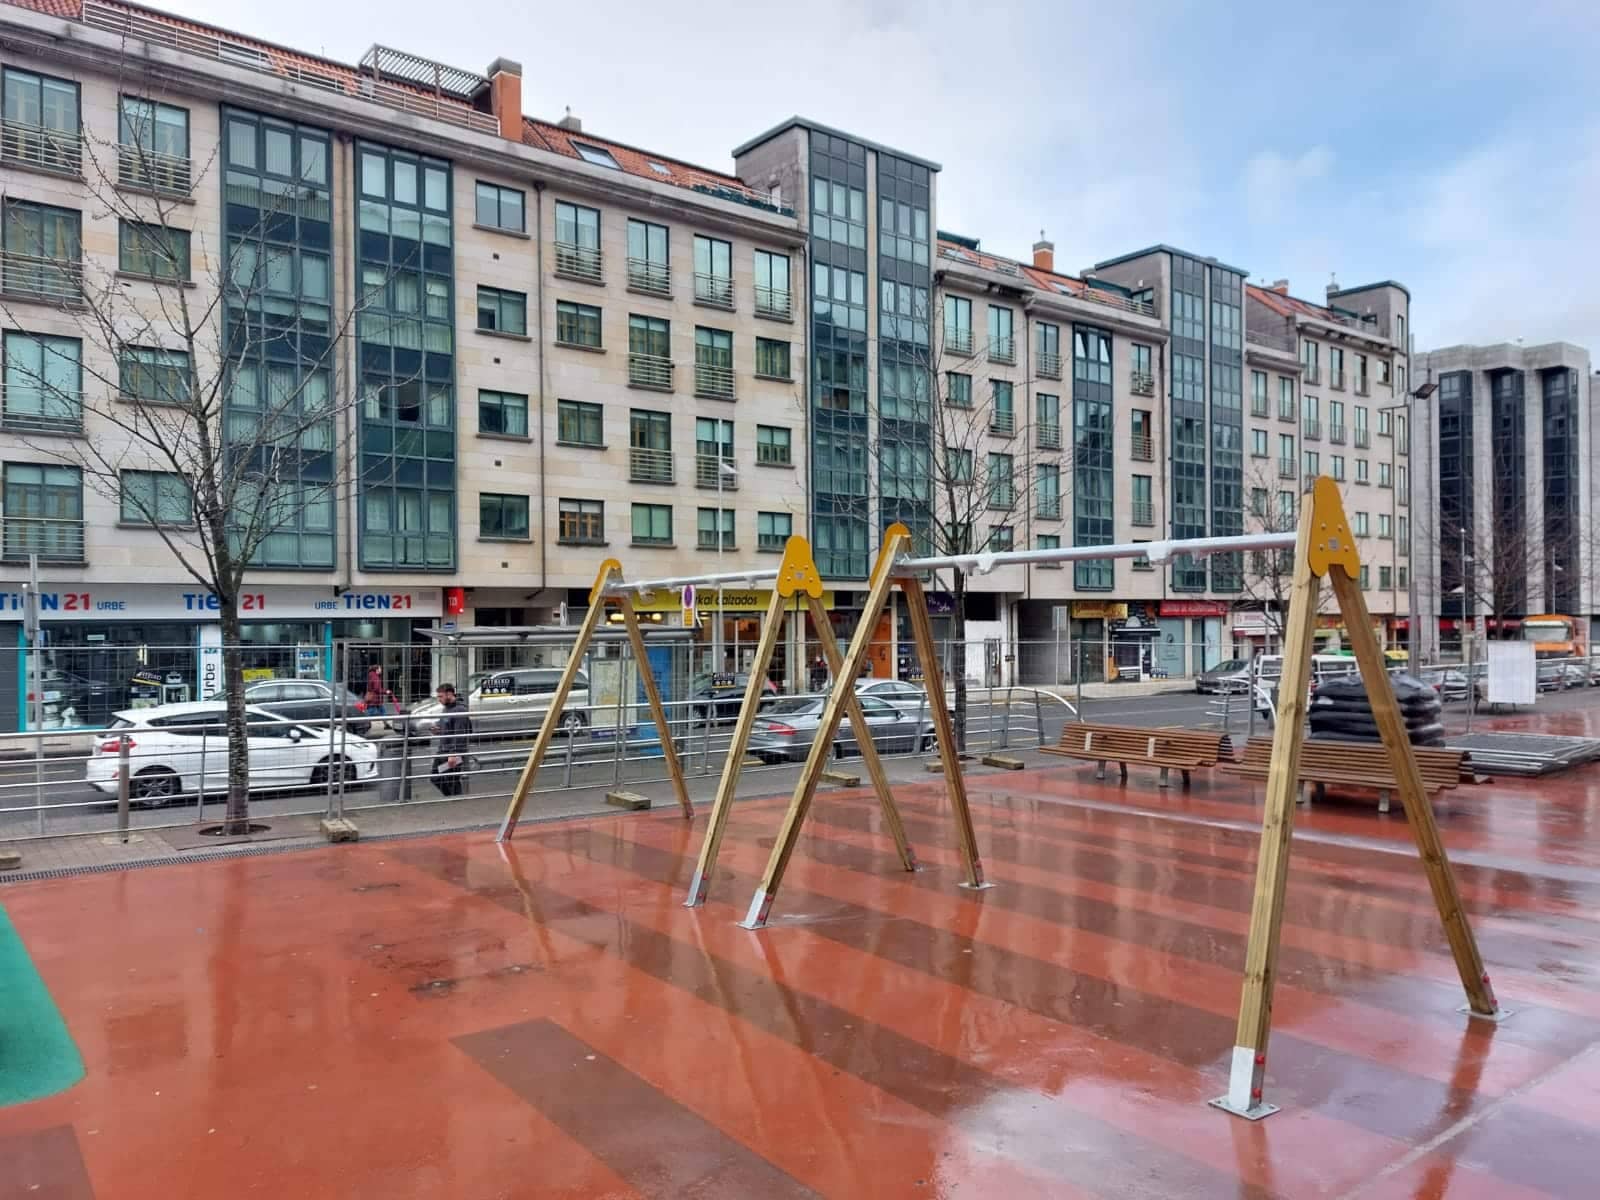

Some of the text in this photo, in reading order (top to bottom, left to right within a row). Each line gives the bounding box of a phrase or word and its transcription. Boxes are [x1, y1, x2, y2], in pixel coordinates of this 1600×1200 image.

[64, 593, 90, 610] 21
[97, 601, 126, 610] URBE
[242, 594, 265, 610] 21
[314, 601, 338, 610] URBE
